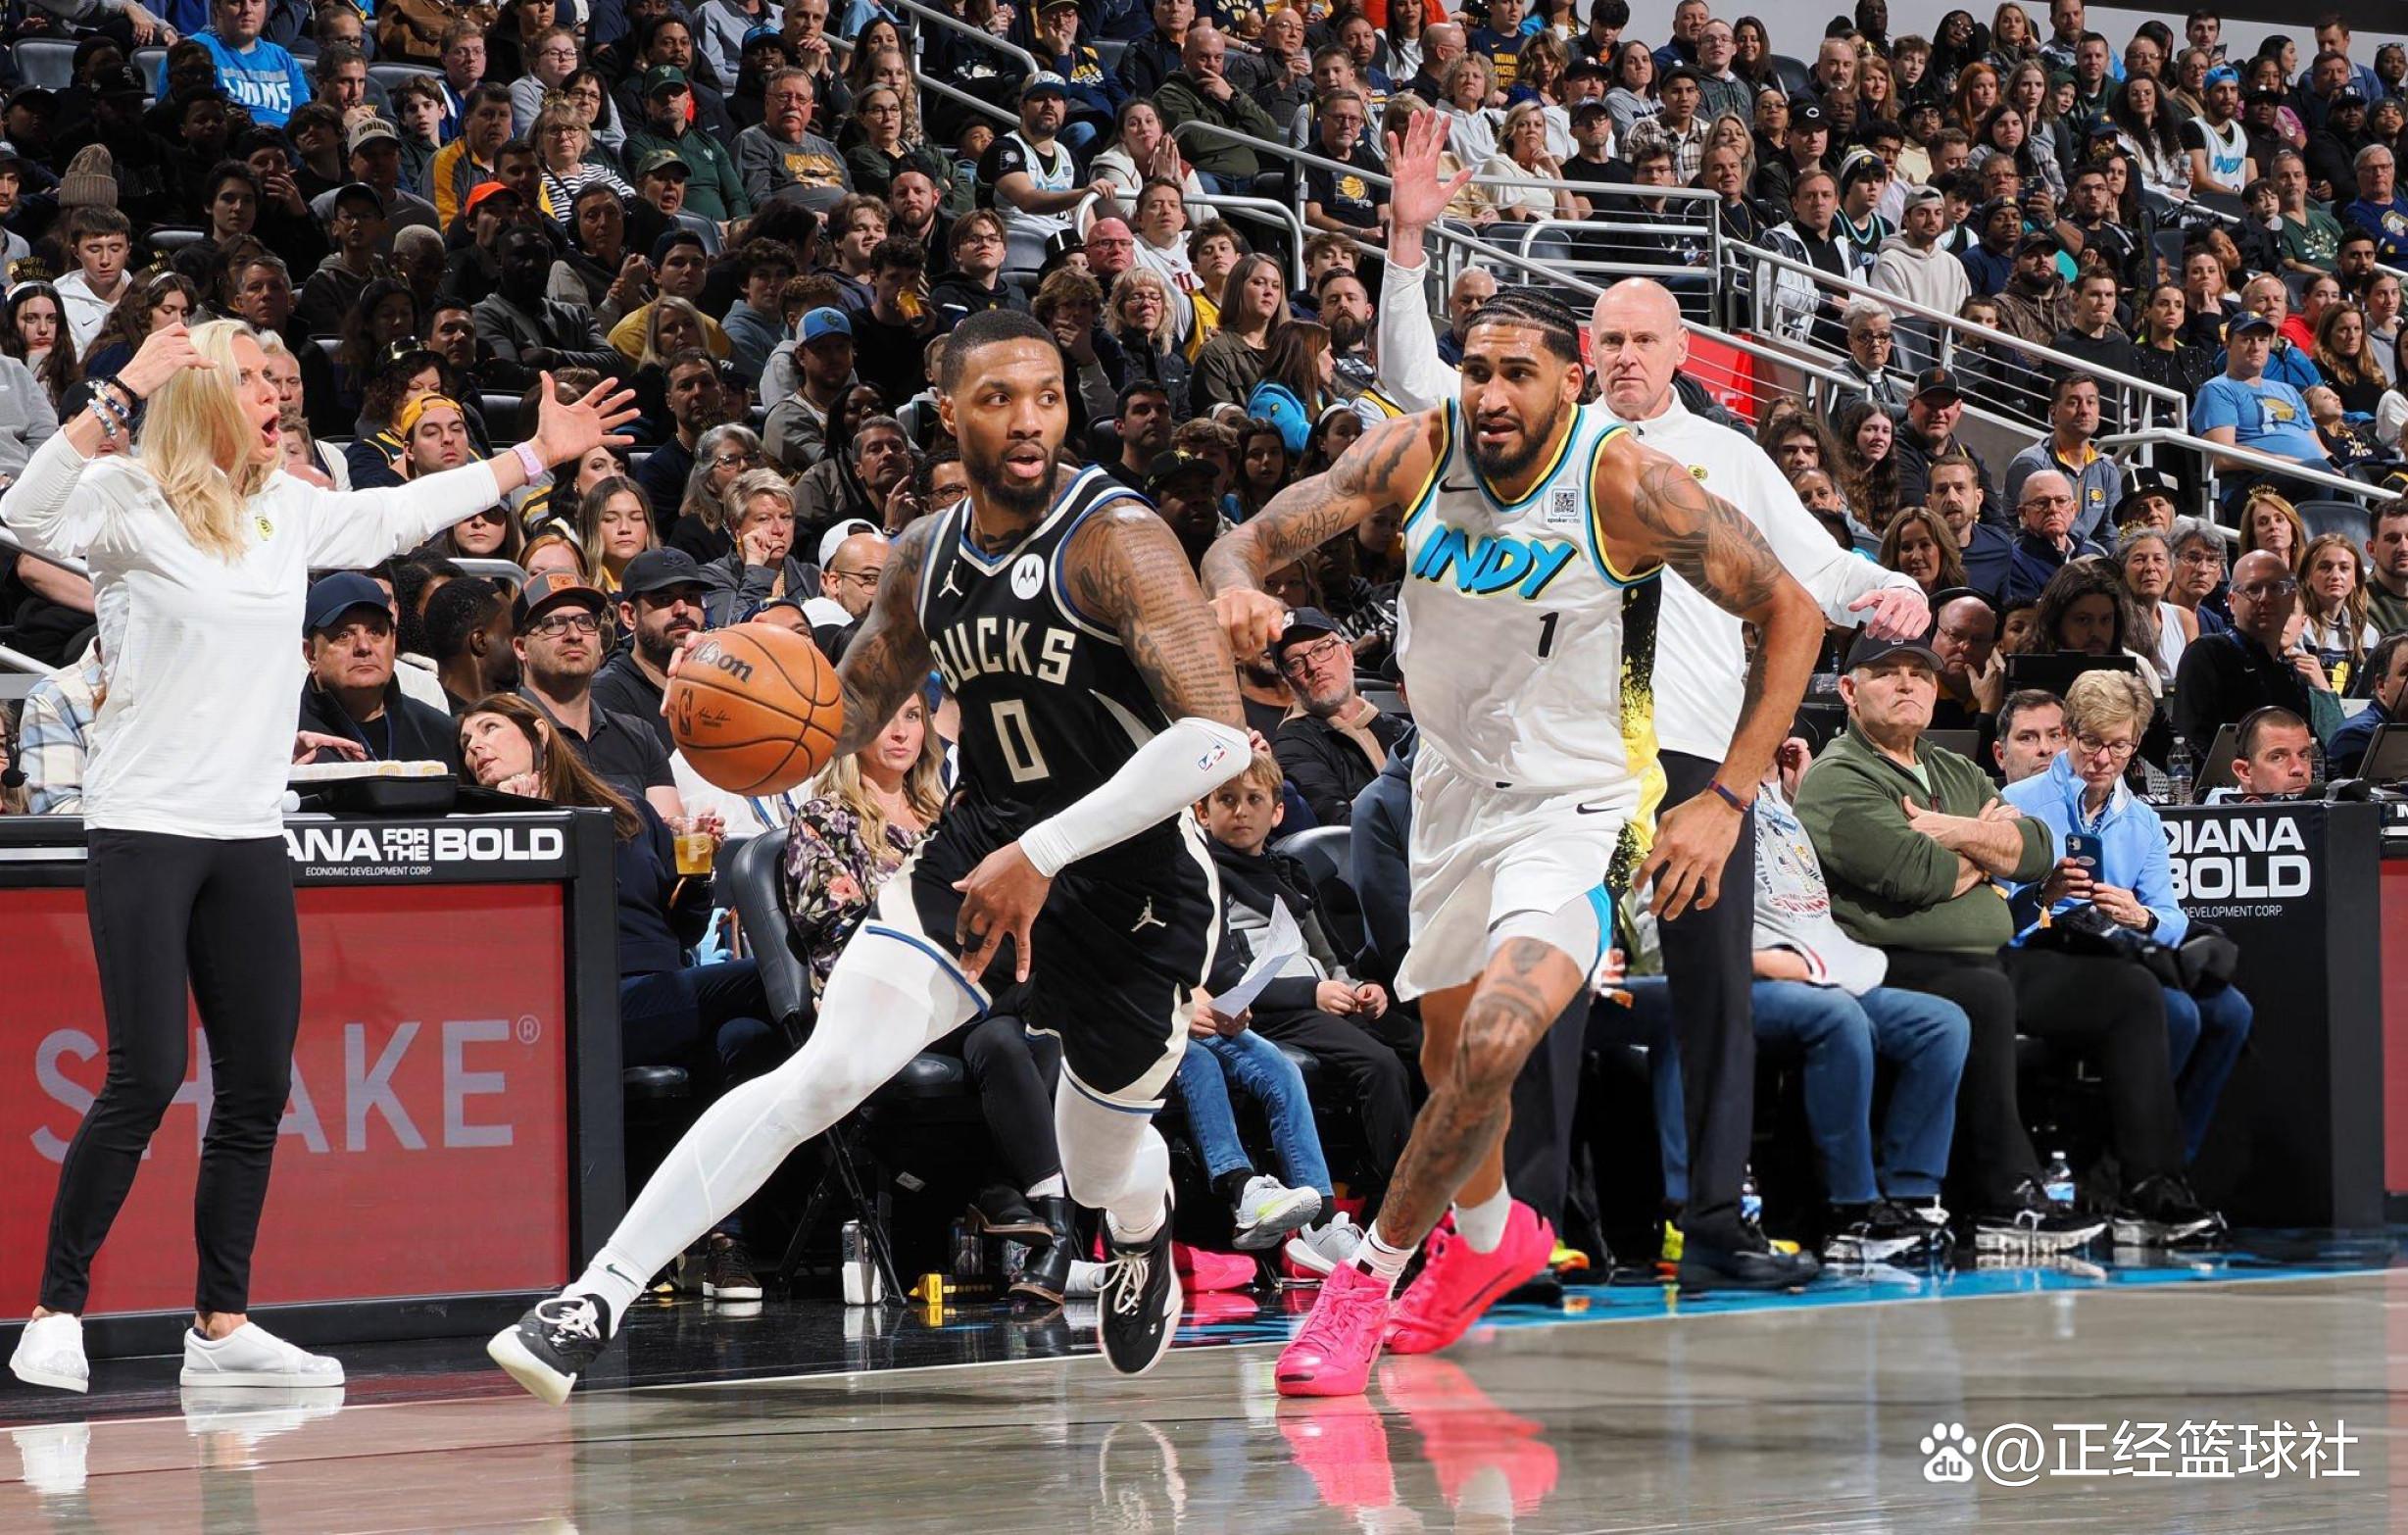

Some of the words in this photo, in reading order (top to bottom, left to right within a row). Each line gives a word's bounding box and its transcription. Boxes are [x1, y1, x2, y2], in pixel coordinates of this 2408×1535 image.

[1410, 522, 1577, 600] INDY
[1539, 611, 1559, 659] 1
[930, 618, 1077, 693] BUCKS
[990, 699, 1051, 783] 0
[382, 828, 429, 845] FOR
[382, 845, 429, 862] THE
[434, 827, 565, 862] BOLD
[305, 866, 349, 876] ECONOMIC
[350, 866, 409, 876] DEVELOPMENT
[2184, 905, 2254, 919] DEVELOPMENT
